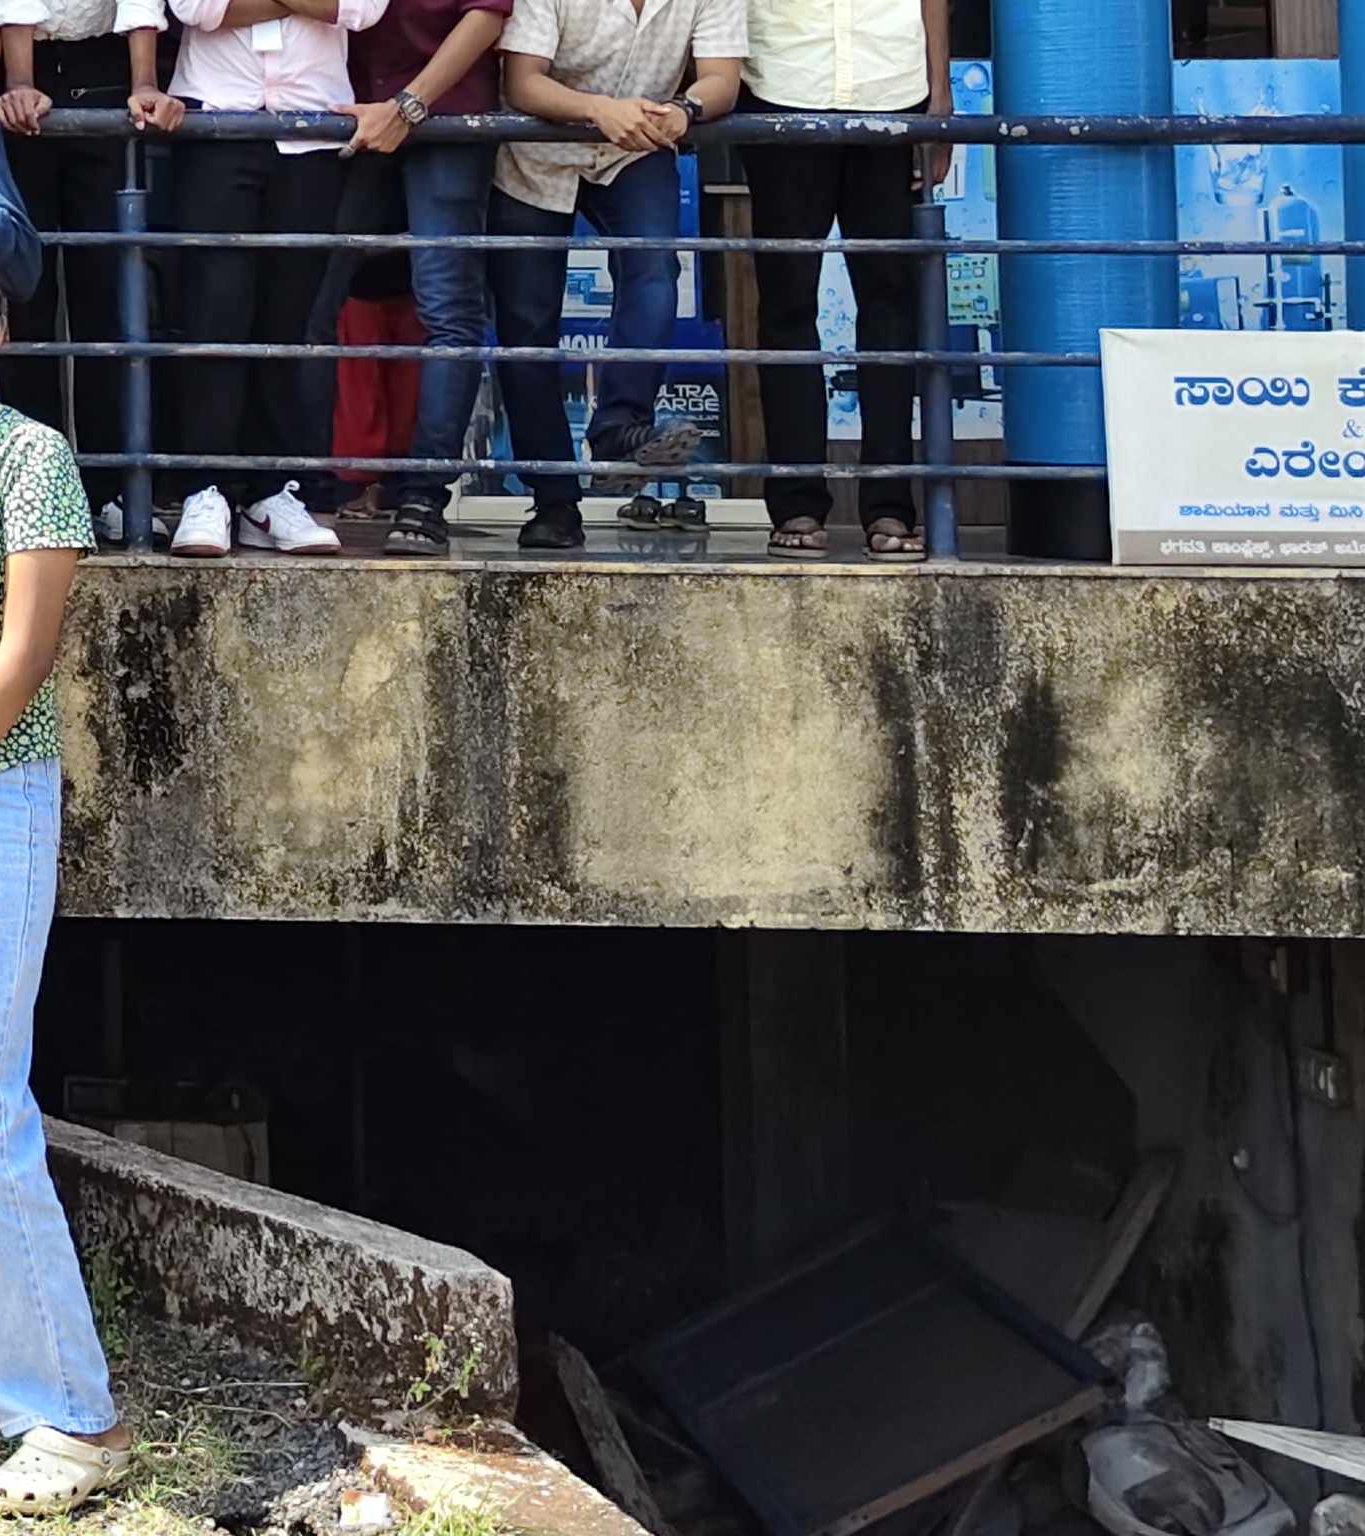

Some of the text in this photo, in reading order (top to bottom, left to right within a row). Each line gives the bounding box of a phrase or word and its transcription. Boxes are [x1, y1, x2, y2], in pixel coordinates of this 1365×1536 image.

[656, 383, 719, 398] LTRA
[654, 397, 720, 412] ARGE
[1342, 418, 1364, 439] &
